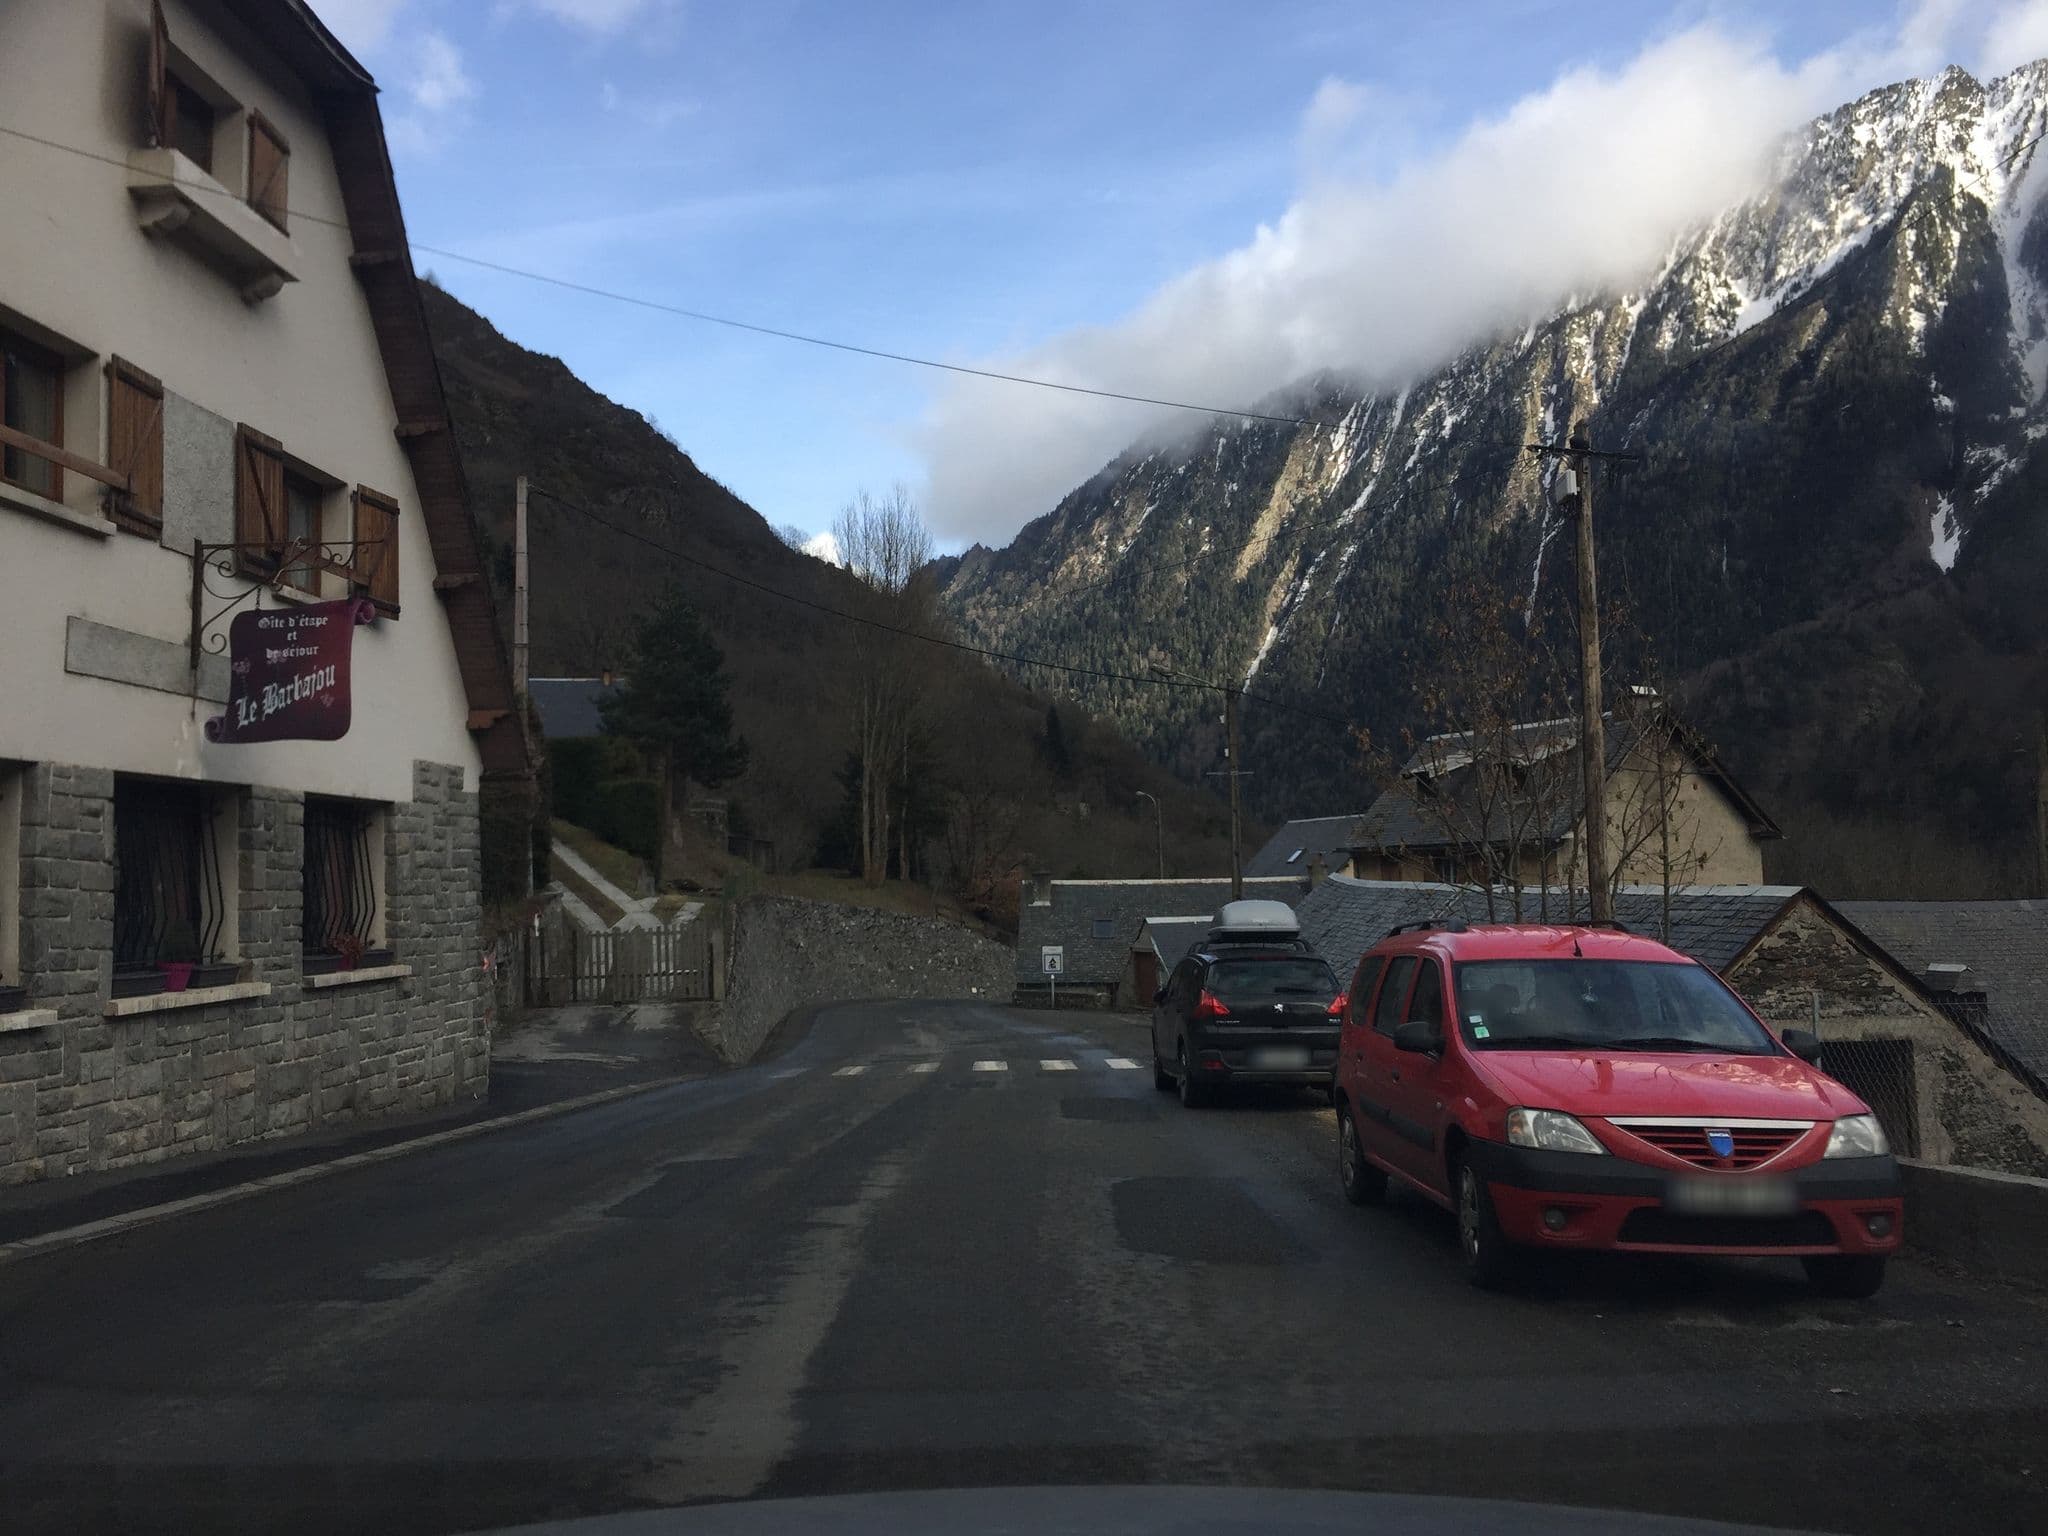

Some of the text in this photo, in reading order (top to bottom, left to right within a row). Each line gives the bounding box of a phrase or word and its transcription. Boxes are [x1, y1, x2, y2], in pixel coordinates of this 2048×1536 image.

[258, 614, 329, 629] Gîte d'étape
[287, 631, 298, 641] et
[282, 644, 319, 658] séjour
[235, 665, 335, 729] Le Barbajou
